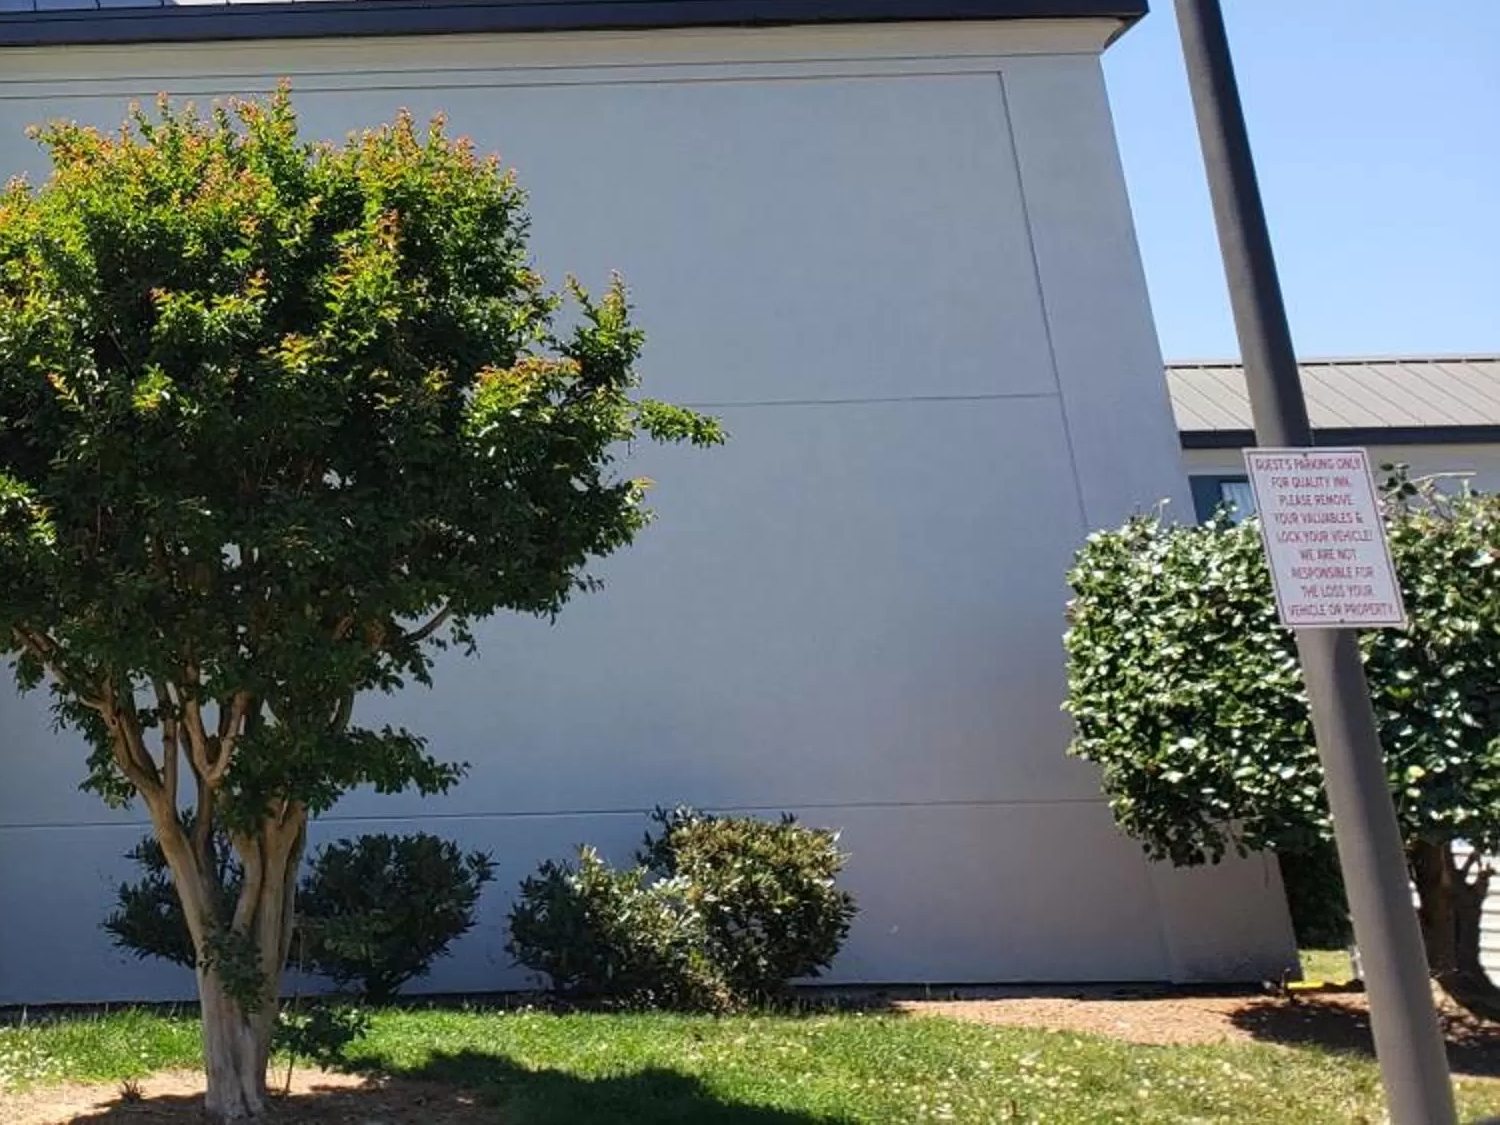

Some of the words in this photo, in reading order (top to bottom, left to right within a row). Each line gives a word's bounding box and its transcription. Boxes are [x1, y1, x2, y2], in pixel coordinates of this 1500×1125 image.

[1294, 458, 1334, 470] PARKING
[1337, 458, 1361, 470] ONLY
[1271, 476, 1289, 488] FOR
[1291, 476, 1330, 488] QUALITY
[1278, 494, 1313, 506] PLEASE
[1314, 494, 1354, 506] REMOVE
[1273, 511, 1299, 524] YOUR
[1300, 511, 1353, 524] VALUABLES
[1276, 530, 1302, 543] LOCK
[1303, 530, 1329, 542] YOUR
[1299, 548, 1314, 560] WE
[1317, 548, 1335, 560] ARE
[1338, 548, 1357, 560] NOT
[1291, 566, 1353, 579] RESPONSIBLE
[1355, 566, 1374, 578] FOR
[1300, 584, 1319, 598] THE
[1321, 584, 1345, 598] LOSS
[1347, 584, 1373, 597] YOUR
[1288, 603, 1327, 616] VEHICLE
[1328, 603, 1342, 615] OR
